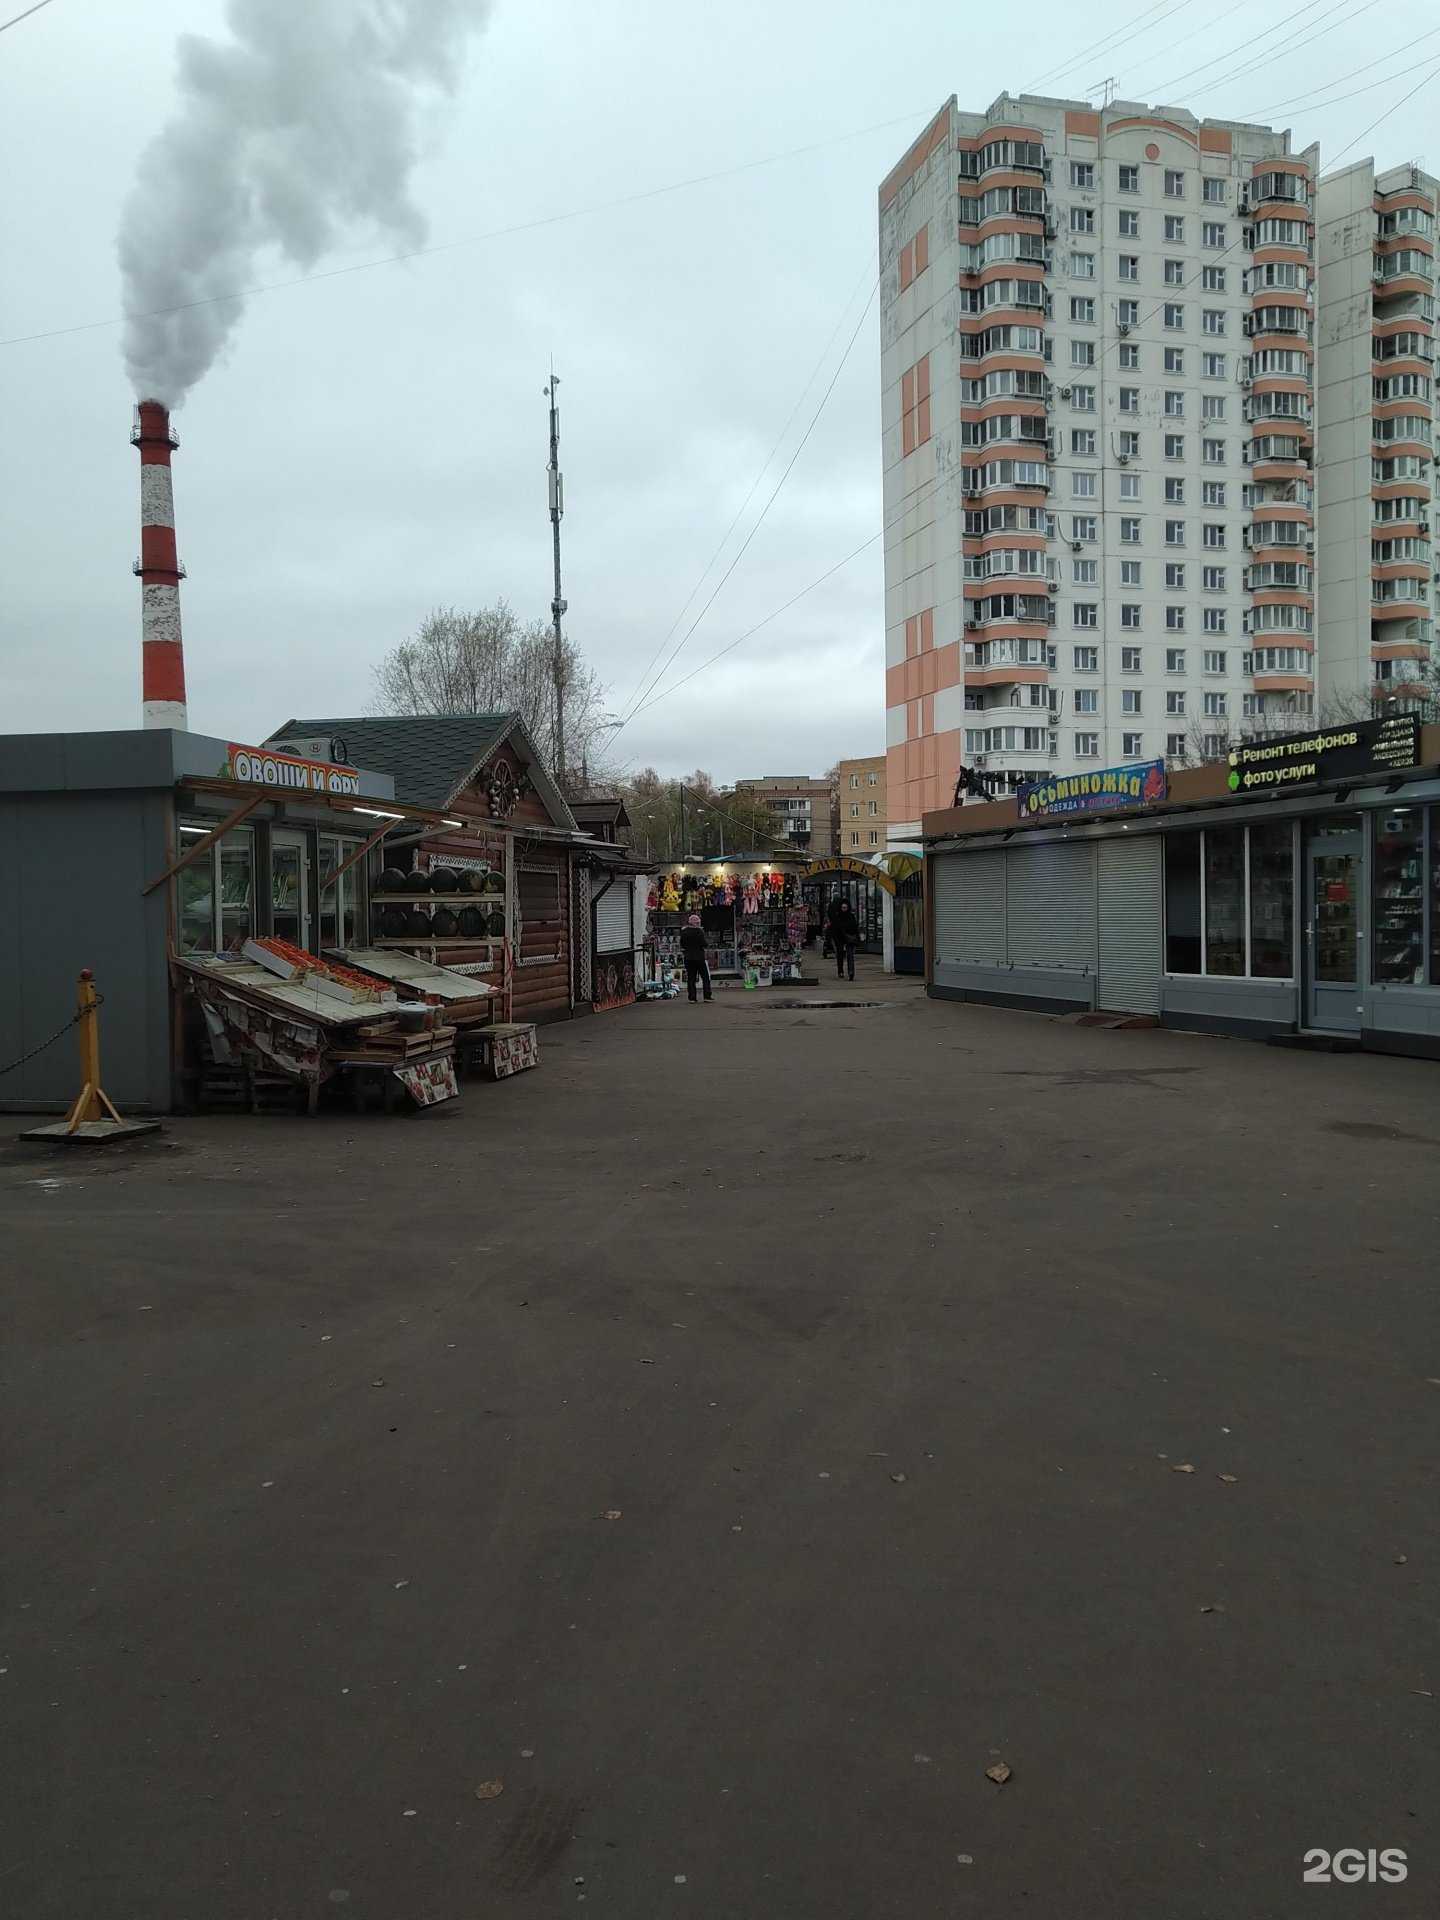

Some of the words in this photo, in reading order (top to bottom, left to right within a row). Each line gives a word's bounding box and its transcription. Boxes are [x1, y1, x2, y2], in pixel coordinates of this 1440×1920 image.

[1243, 745, 1287, 763] Ремонт
[1287, 732, 1358, 755] телефонов
[1275, 763, 1316, 784] услуги
[1049, 800, 1078, 813] ОДЕЖДА
